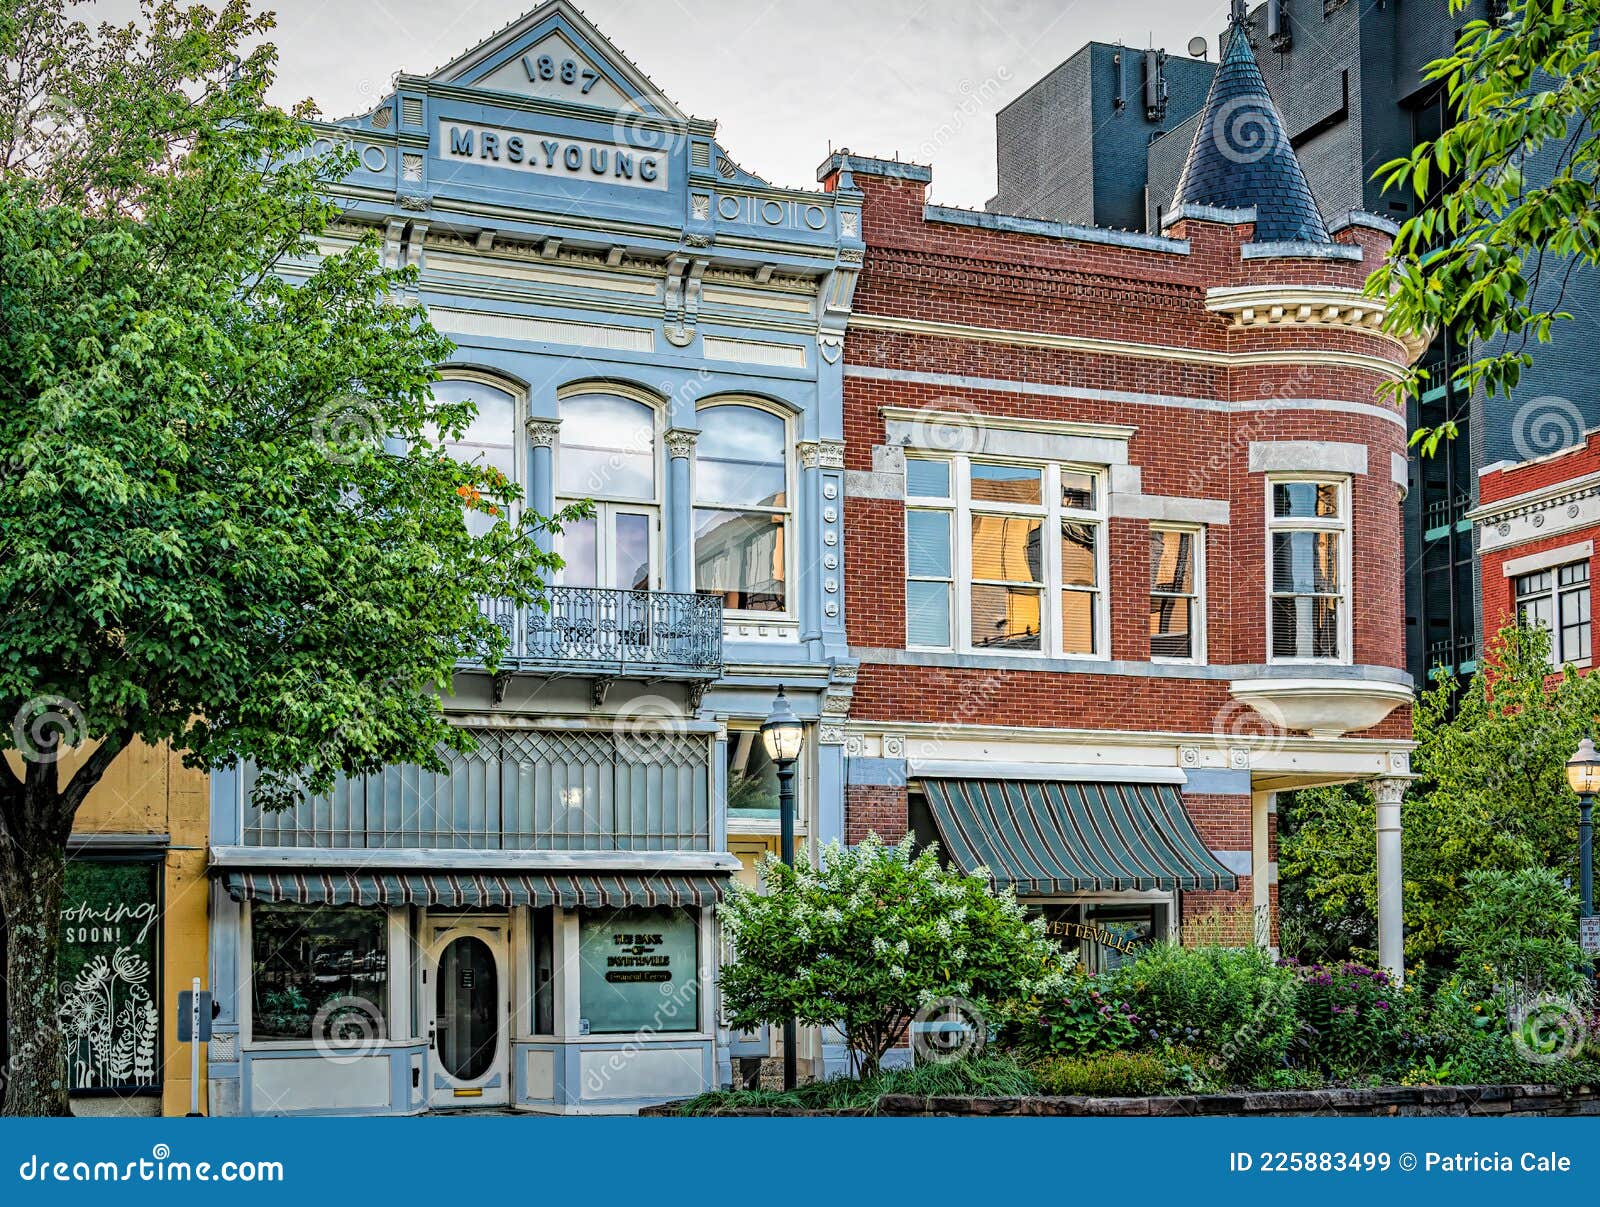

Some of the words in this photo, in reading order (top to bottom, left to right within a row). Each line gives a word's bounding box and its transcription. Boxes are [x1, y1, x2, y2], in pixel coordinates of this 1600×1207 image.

[522, 54, 601, 95] 1887
[60, 900, 159, 944] oming
[66, 927, 121, 943] SOON!
